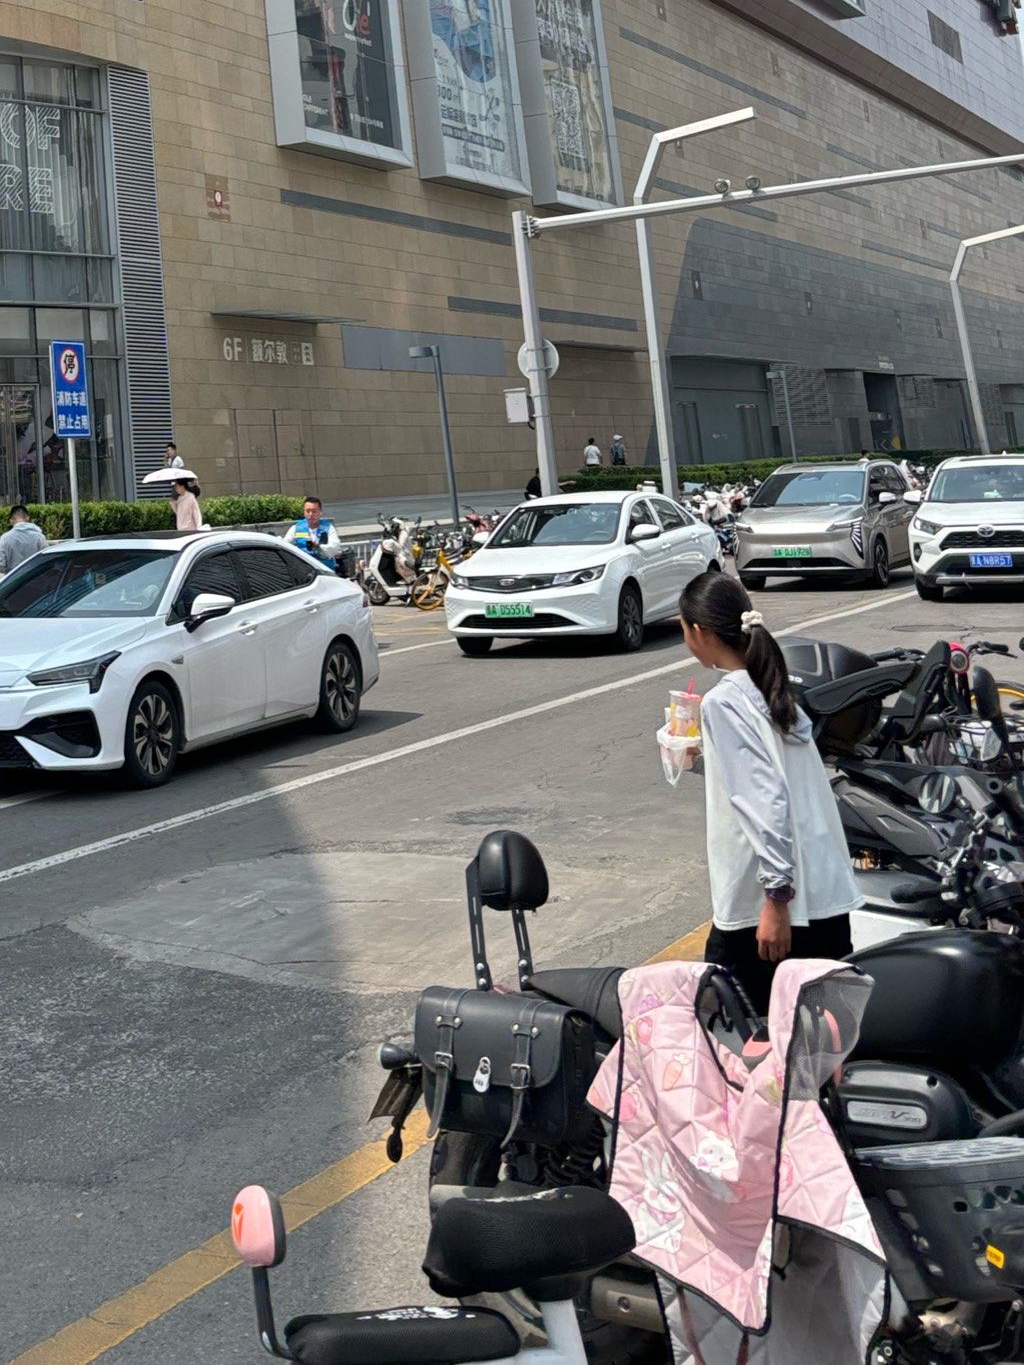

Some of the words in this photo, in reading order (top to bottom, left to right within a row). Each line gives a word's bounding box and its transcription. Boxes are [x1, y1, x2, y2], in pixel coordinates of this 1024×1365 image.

[1, 101, 61, 150] OF
[223, 337, 242, 361] 6F
[56, 391, 86, 406] 消防车道
[58, 414, 88, 429] 禁止占用
